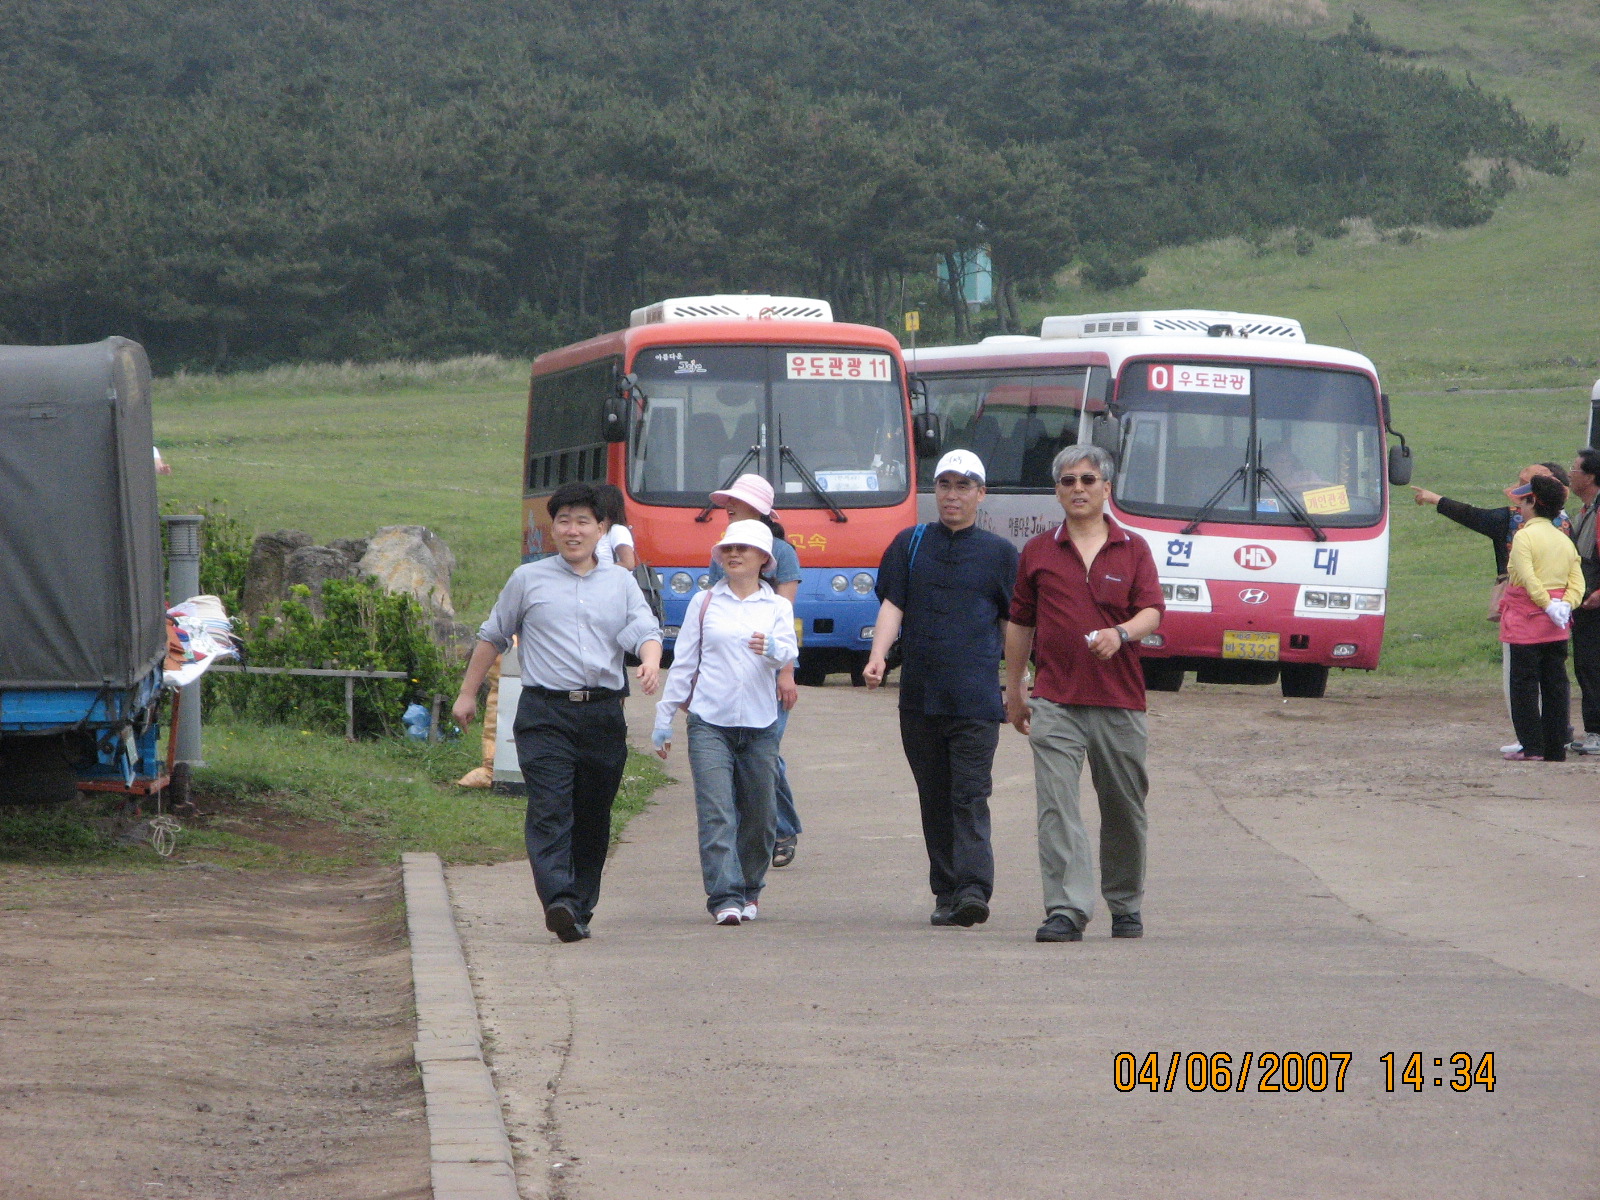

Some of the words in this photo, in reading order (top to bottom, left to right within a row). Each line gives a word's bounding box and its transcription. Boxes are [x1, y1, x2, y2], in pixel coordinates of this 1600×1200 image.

[655, 352, 683, 361] 아름다운
[791, 356, 862, 378] 우도관광
[869, 357, 888, 378] 11
[1151, 366, 1169, 389] 0
[1178, 371, 1245, 391] 우도관광
[1009, 516, 1029, 537] 아름다운
[1166, 539, 1193, 567] 현
[1314, 548, 1339, 576] 대
